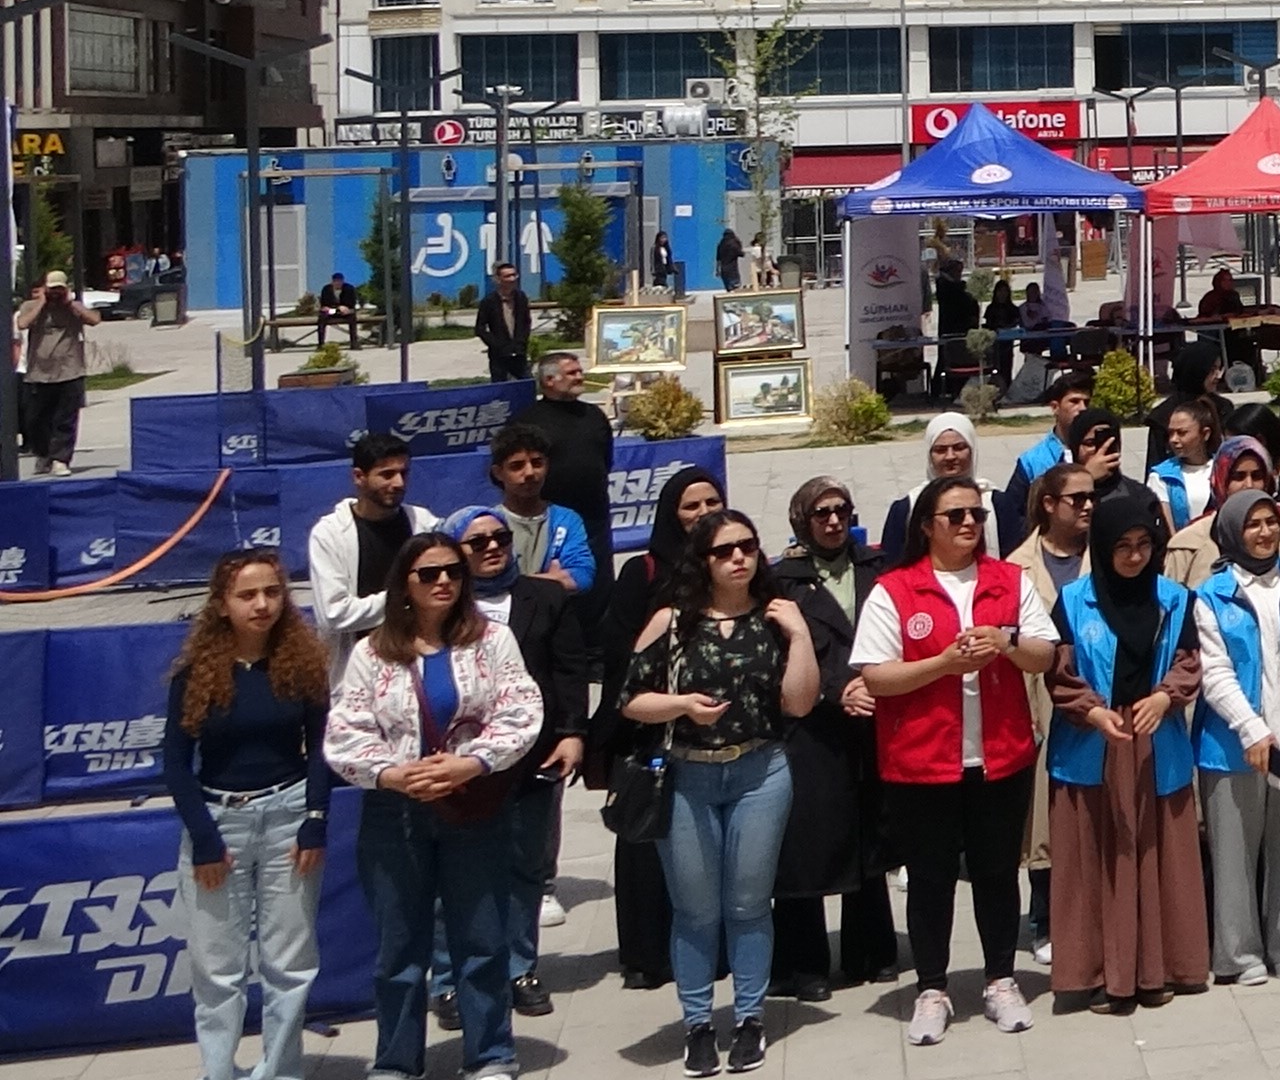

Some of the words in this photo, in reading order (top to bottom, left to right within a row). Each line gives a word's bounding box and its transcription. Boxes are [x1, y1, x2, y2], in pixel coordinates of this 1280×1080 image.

[508, 116, 531, 128] AVA
[998, 109, 1066, 129] afone
[989, 197, 1019, 208] SPOR
[609, 504, 658, 529] DH
[84, 748, 164, 772] DHS
[0, 870, 190, 968] 红双
